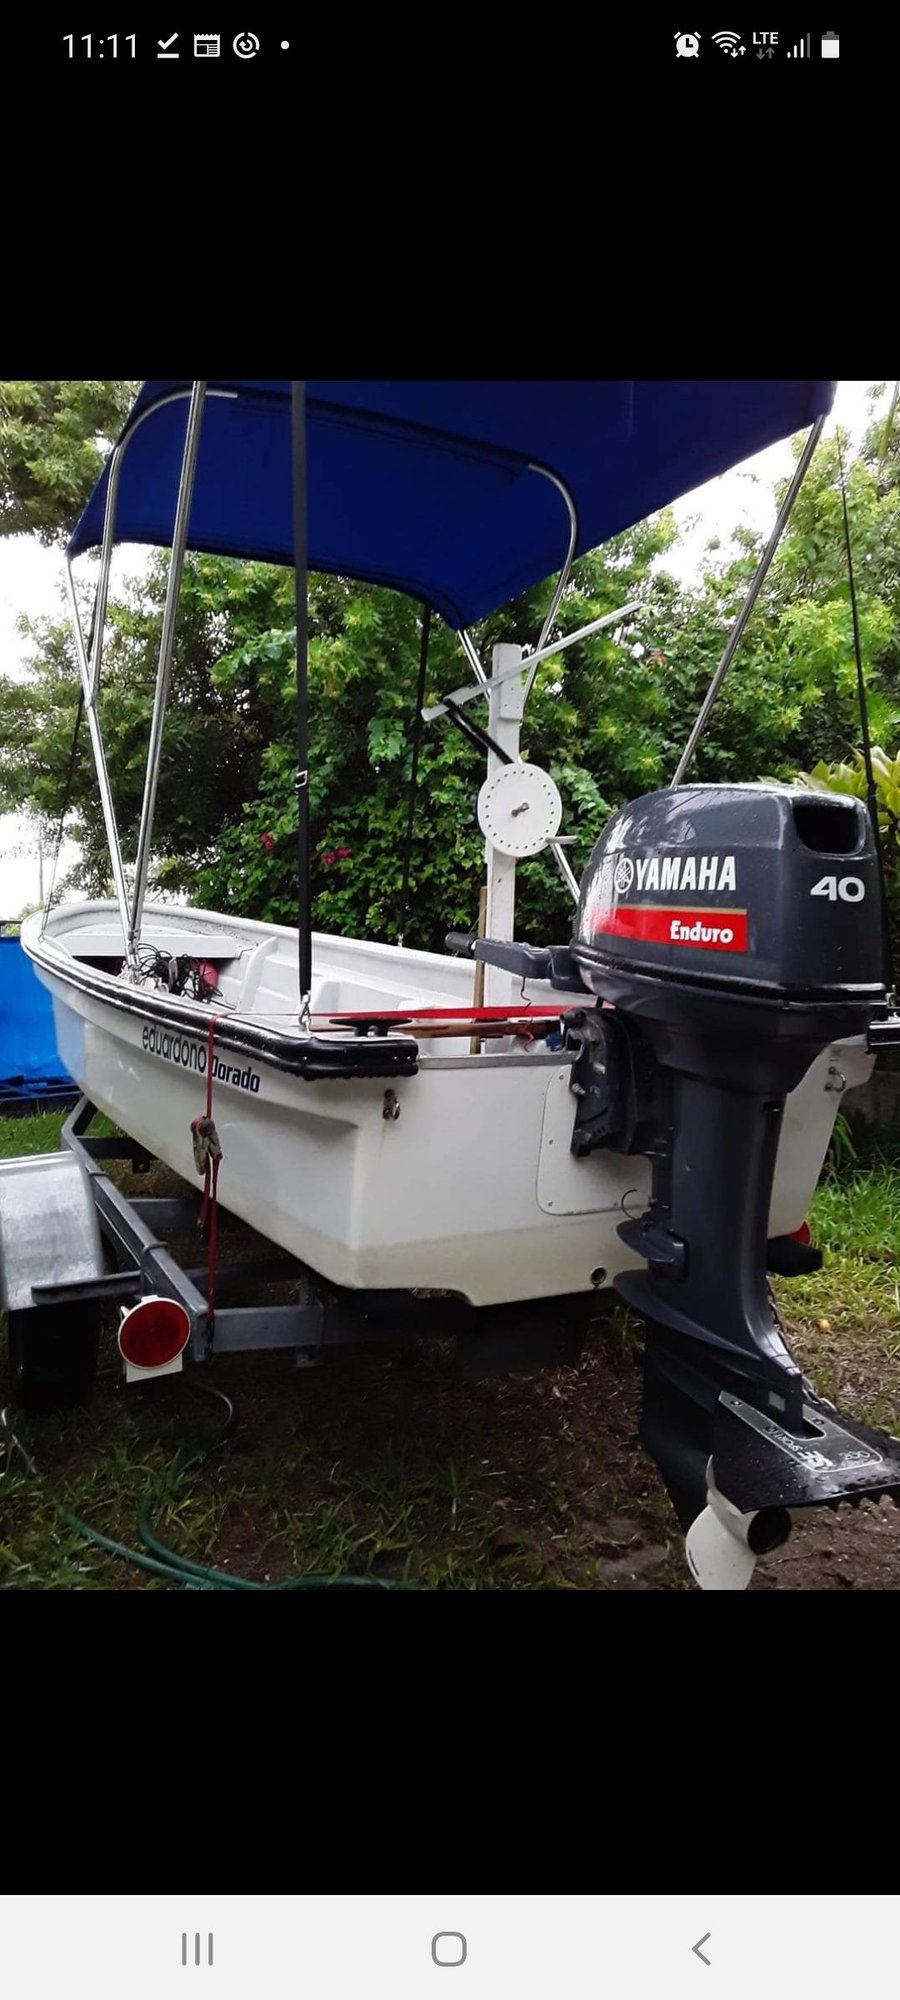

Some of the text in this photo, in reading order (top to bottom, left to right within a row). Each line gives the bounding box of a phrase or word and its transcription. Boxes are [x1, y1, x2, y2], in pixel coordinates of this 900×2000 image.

[635, 855, 737, 891] YAMAHA
[810, 876, 865, 902] 40
[670, 920, 734, 944] Enduro
[142, 1024, 207, 1074] eduardono
